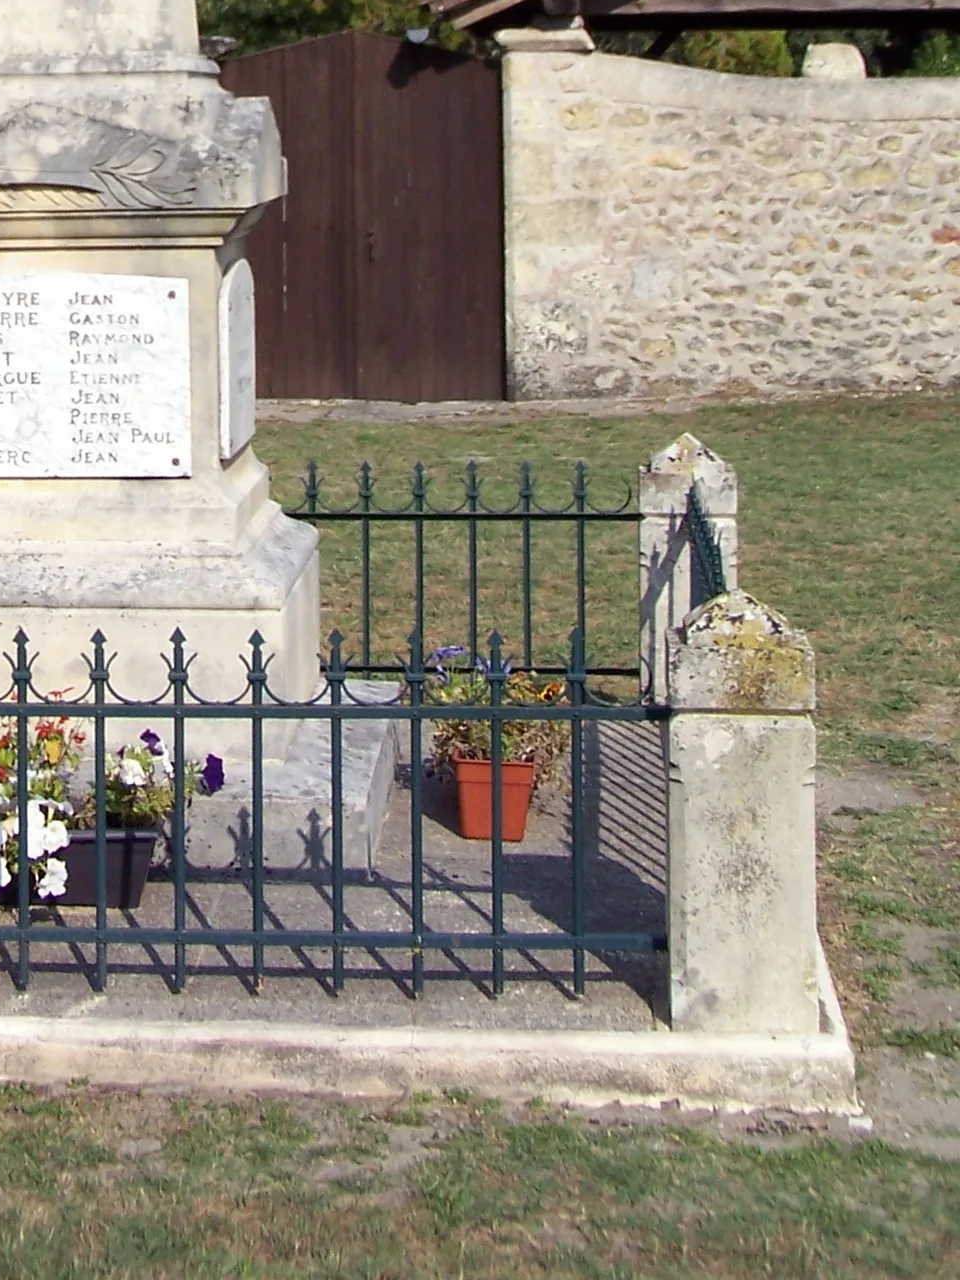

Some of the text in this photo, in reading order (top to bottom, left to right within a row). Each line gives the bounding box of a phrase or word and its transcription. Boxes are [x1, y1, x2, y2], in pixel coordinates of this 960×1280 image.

[68, 292, 113, 306] JEAN
[69, 311, 139, 325] GASTON
[69, 330, 154, 347] RAYMOND
[70, 350, 117, 365] JEAN
[71, 389, 119, 404] JEAN
[68, 408, 132, 426] PIERRE
[72, 429, 119, 444] JEAN
[131, 428, 175, 443] PAUL
[71, 448, 118, 463] JEAN
